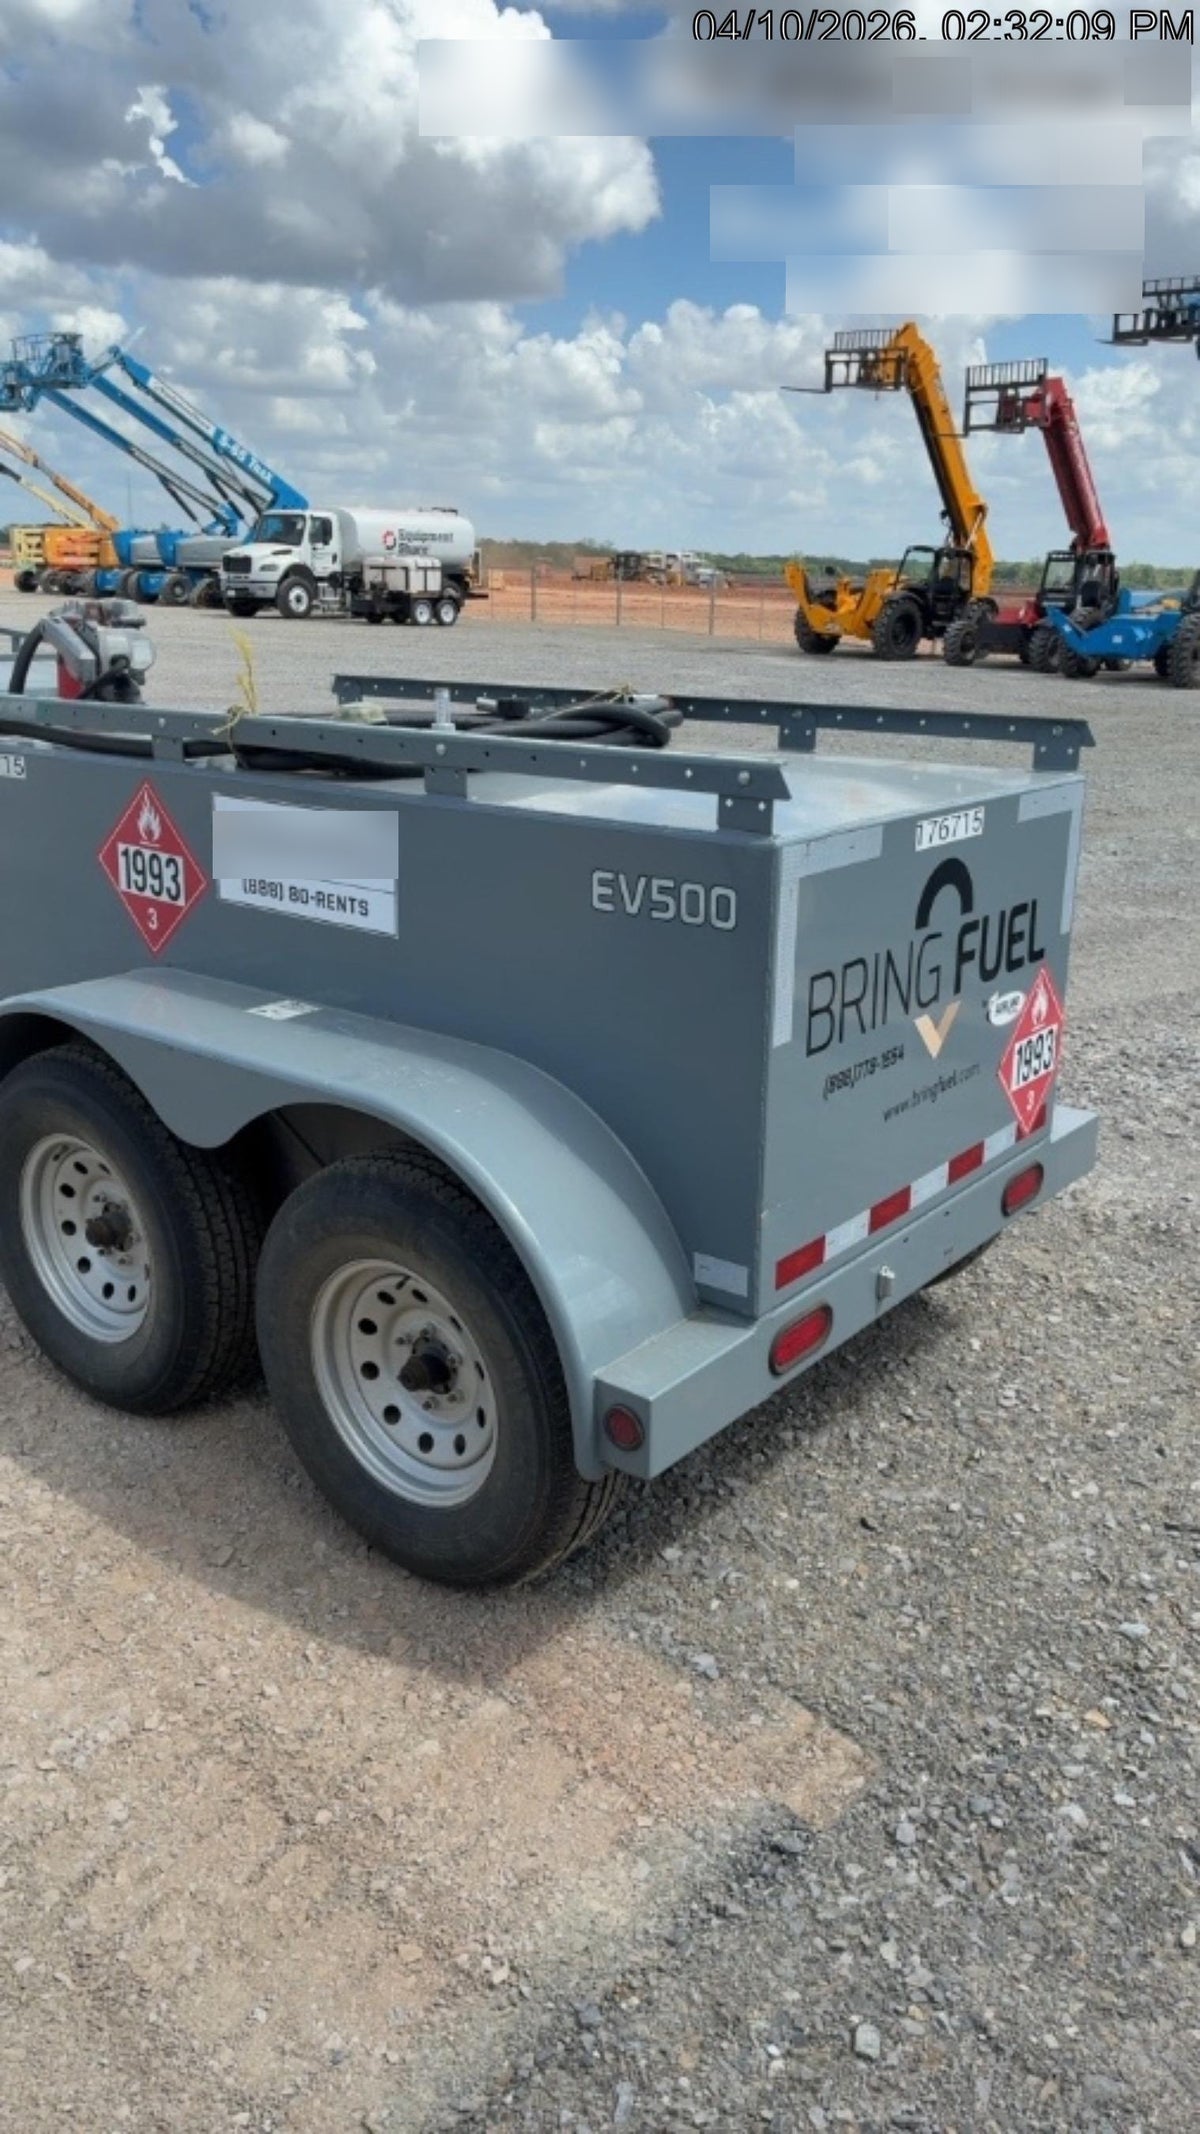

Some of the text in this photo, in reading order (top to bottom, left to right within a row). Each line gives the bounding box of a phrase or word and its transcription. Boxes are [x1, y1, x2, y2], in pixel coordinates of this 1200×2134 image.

[915, 810, 983, 847] 176715
[121, 847, 181, 901] 1993
[591, 869, 737, 931] EV500
[147, 907, 158, 930] 3
[806, 898, 1046, 1059] BRING FUEL
[1014, 1027, 1055, 1087] 1993
[1026, 1090, 1036, 1111] 3
